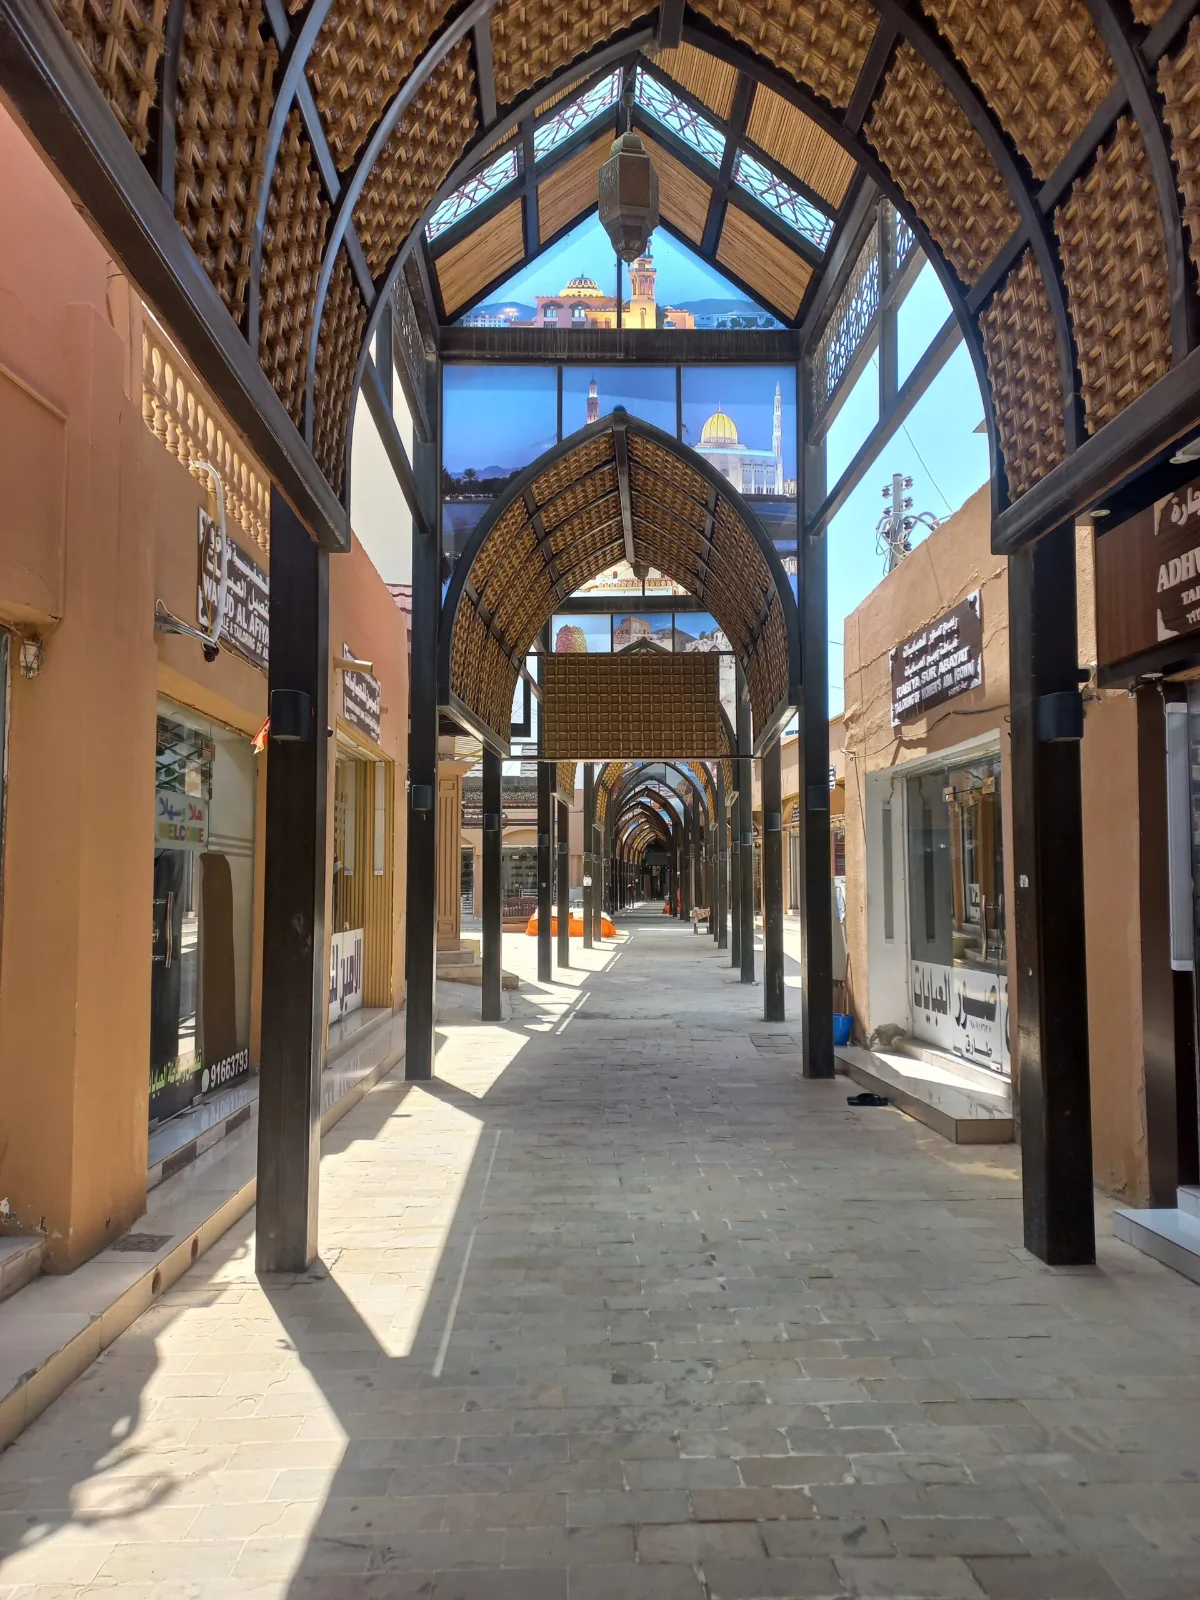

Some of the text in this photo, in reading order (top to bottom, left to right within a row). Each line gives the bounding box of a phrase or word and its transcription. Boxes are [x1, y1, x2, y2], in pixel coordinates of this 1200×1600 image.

[236, 603, 248, 630] AL
[256, 641, 263, 654] OF
[921, 665, 937, 685] SUR
[938, 645, 970, 676] ABAYAT
[158, 822, 204, 843] WELCOME
[210, 1048, 249, 1088] 91663793
